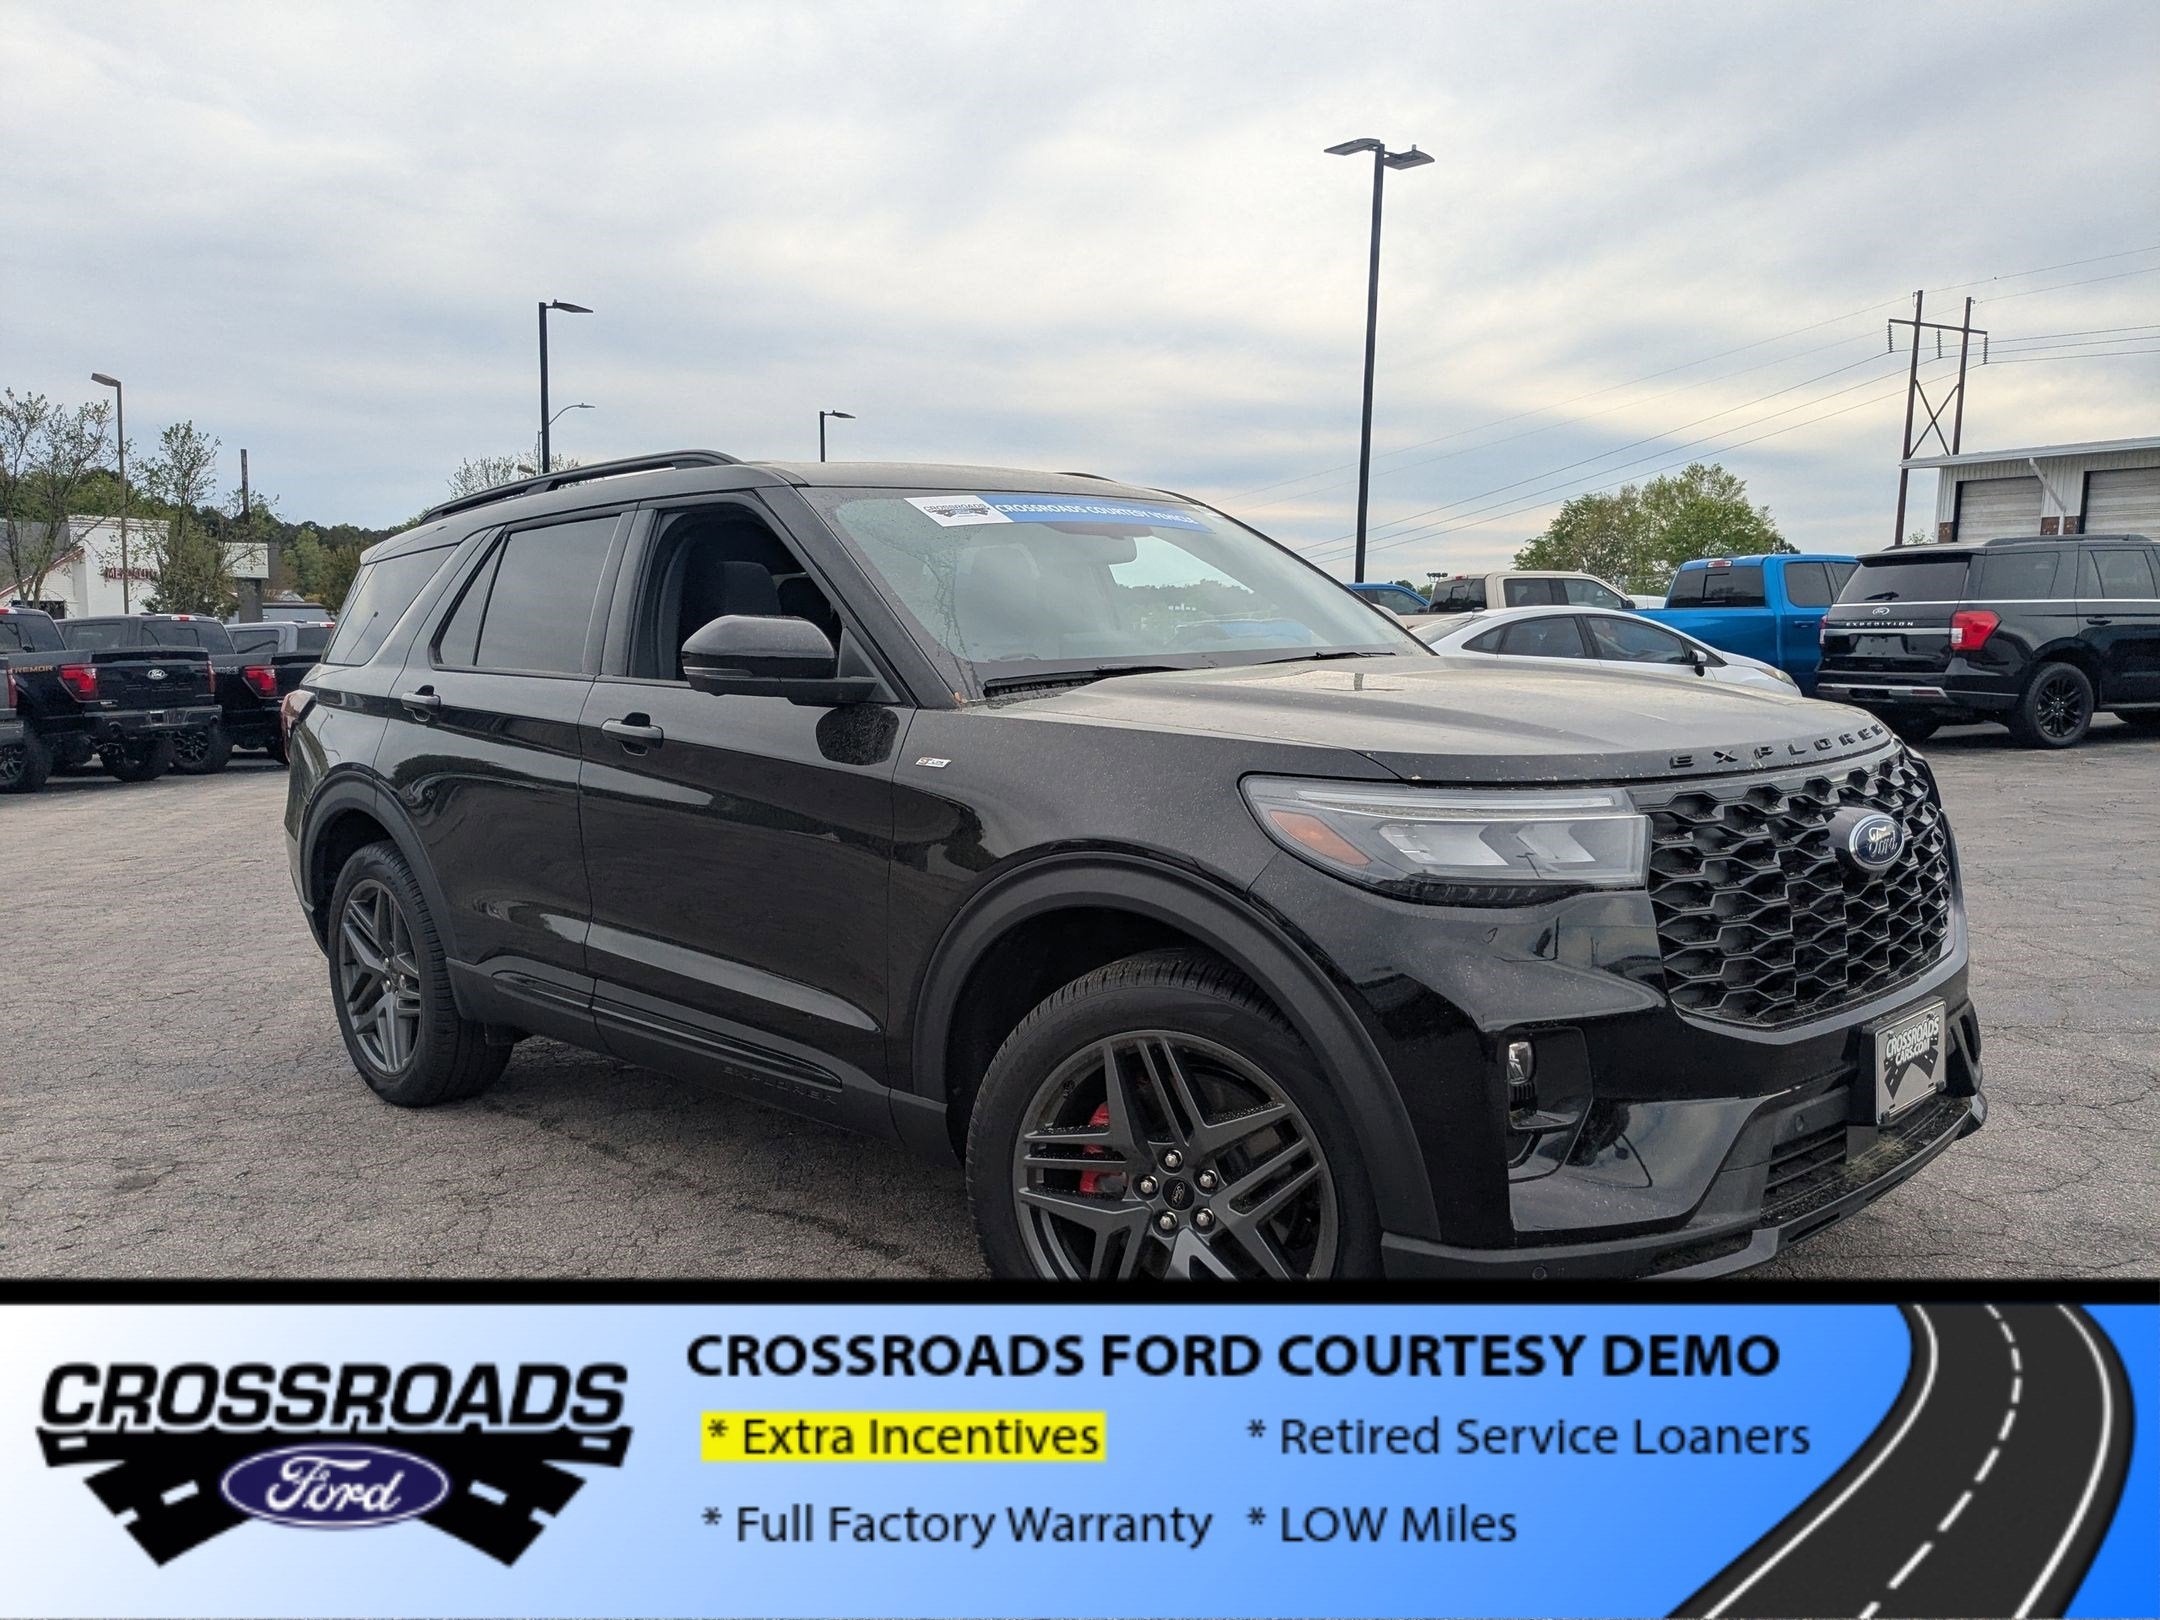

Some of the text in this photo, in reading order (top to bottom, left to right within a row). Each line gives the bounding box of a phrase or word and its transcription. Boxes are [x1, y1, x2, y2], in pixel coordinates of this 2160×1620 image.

[995, 503, 1087, 514] CROSSROADS
[1669, 723, 1884, 769] EXPLORER
[1885, 1016, 1940, 1060] CROSSROADS
[1895, 1039, 1931, 1066] CARS.COM
